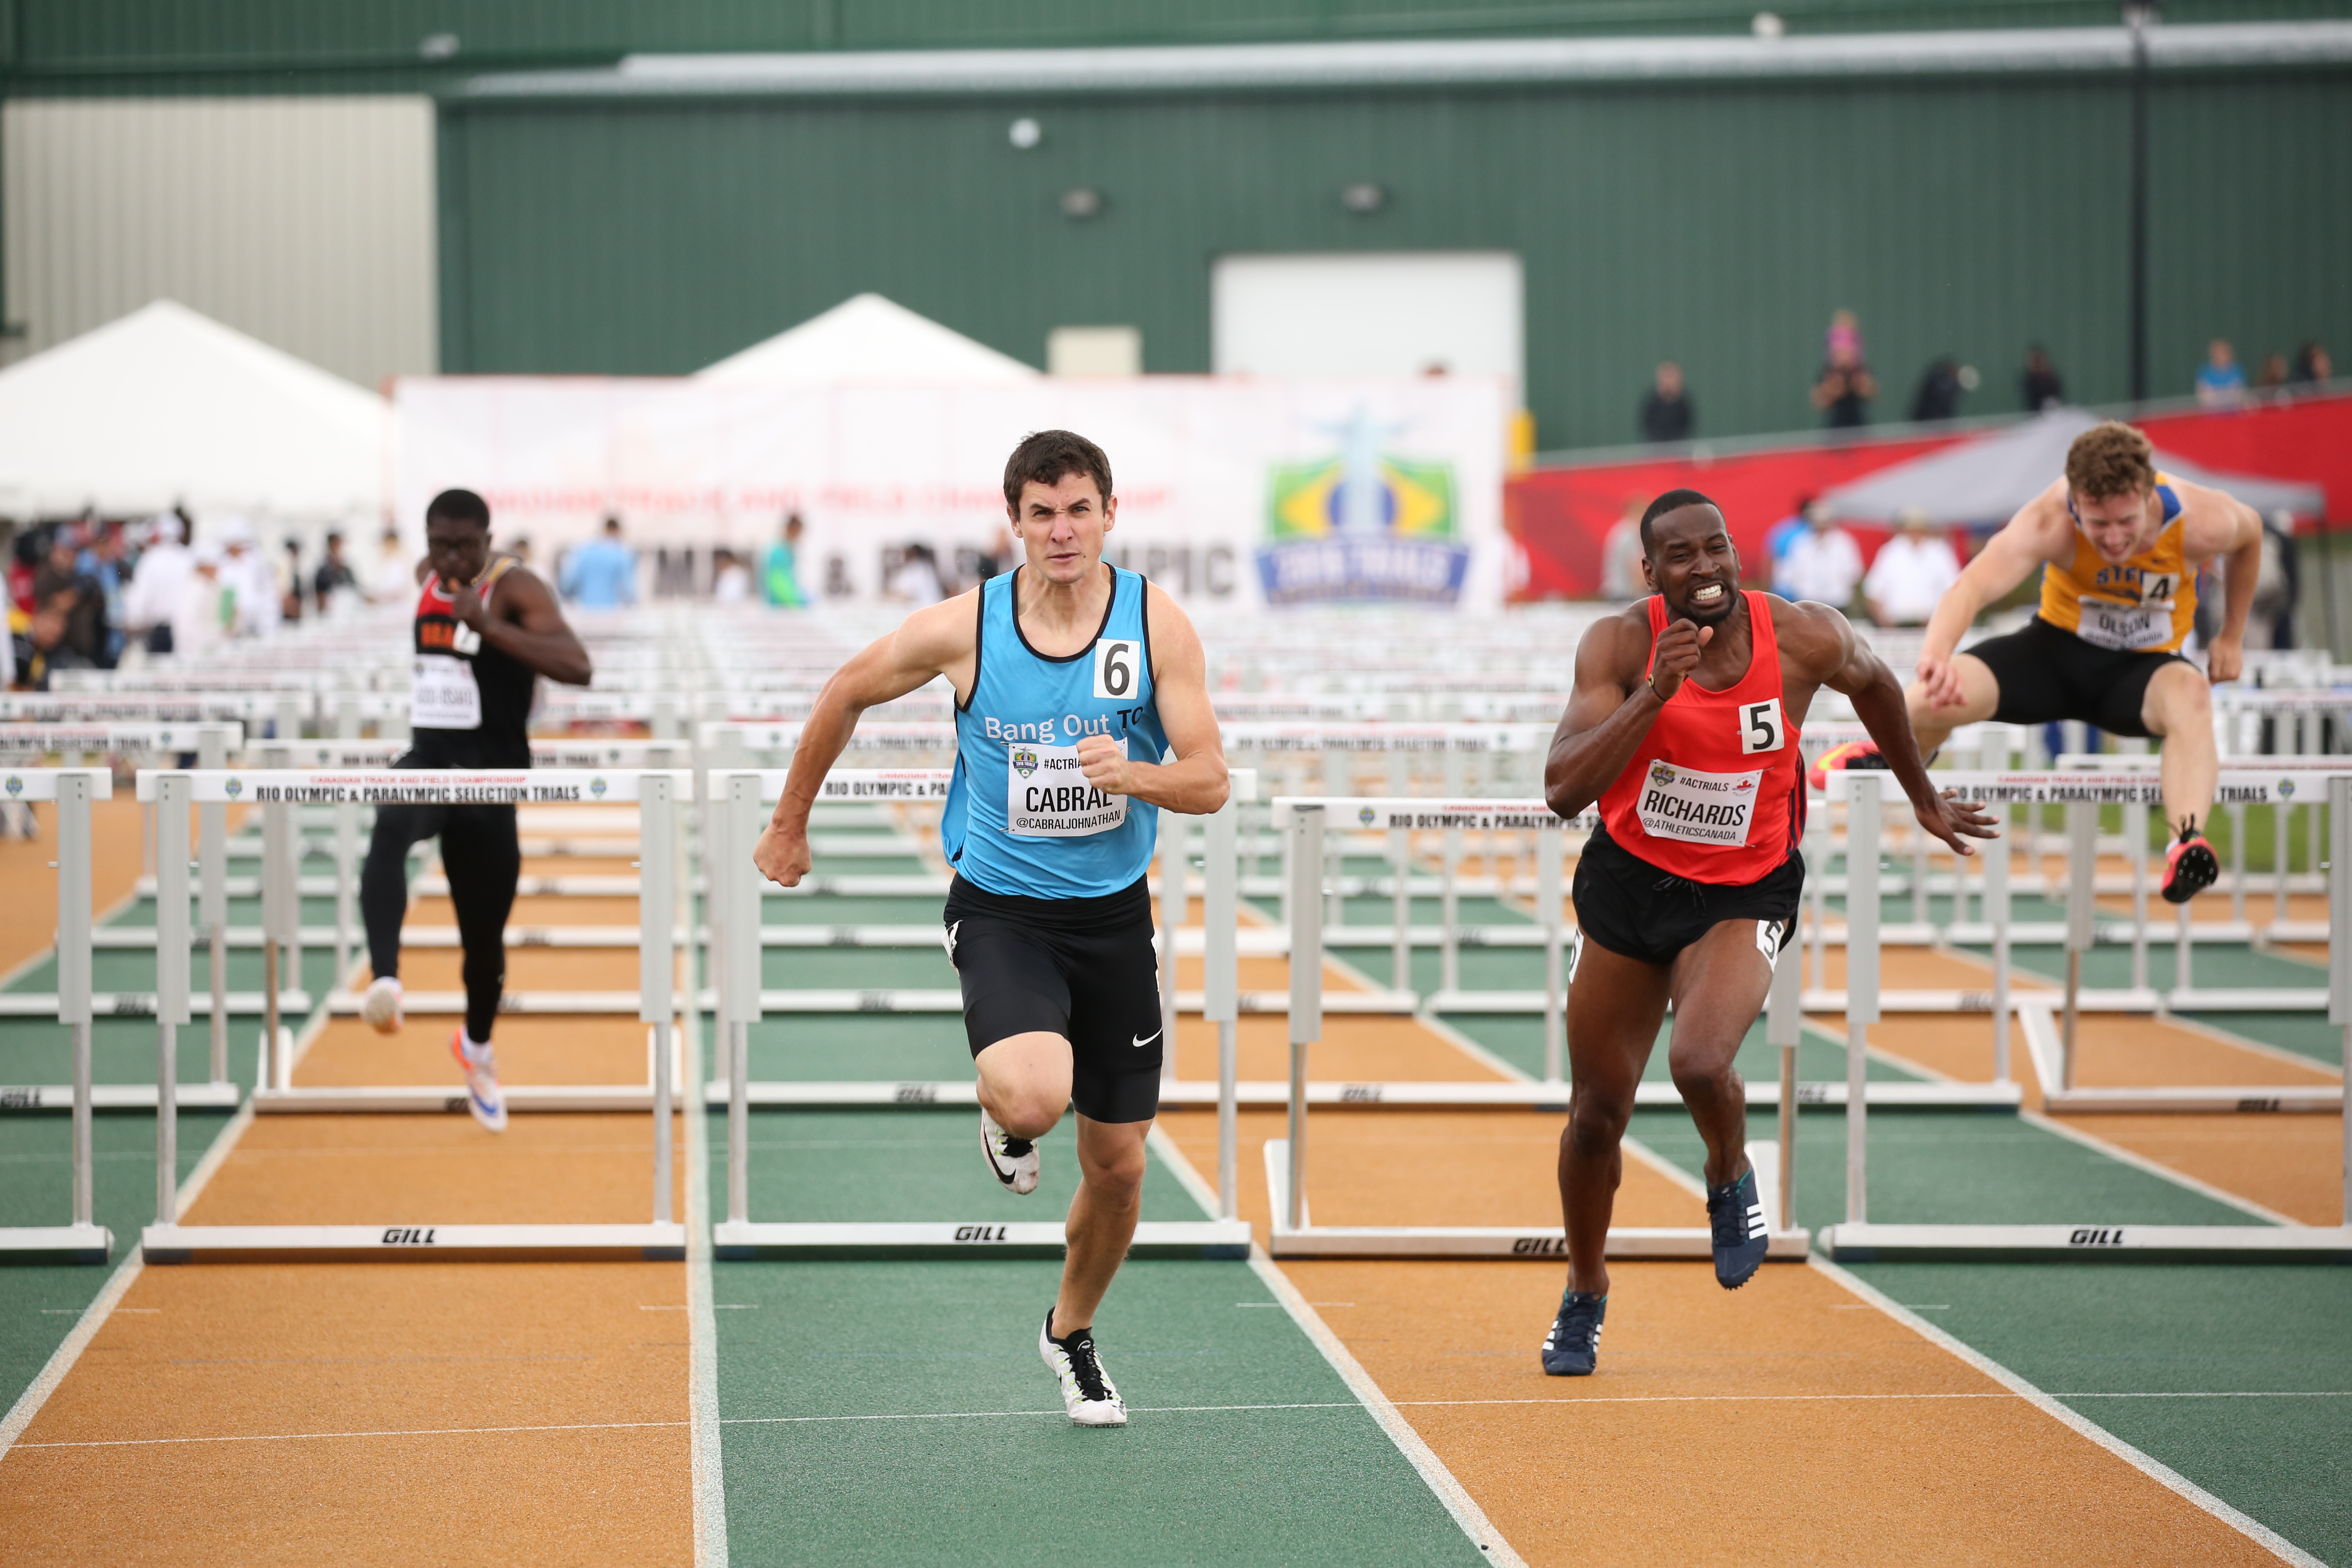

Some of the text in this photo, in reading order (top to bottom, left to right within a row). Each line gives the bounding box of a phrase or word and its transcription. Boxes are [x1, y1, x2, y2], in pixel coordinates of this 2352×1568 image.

[2149, 576, 2169, 599] 4
[2099, 612, 2150, 637] OLSON
[1104, 643, 1130, 696] 6
[984, 717, 1056, 744] Bang
[1063, 714, 1111, 737] Out
[1116, 706, 1143, 730] TC
[1750, 704, 1775, 750] 5
[825, 783, 848, 795] RIO
[853, 783, 912, 795] OLYMPIC
[918, 785, 925, 795] &
[1679, 776, 1729, 792] #ACTRIALS
[256, 787, 580, 800] RIO OLYMPIC & PARALYMPIC SELECTION TRIALS
[1025, 786, 1113, 813] CABRAL
[1973, 787, 2032, 800] OLYMPIC
[2051, 787, 2136, 801] PARALYMPIC
[2221, 787, 2267, 800] TRIALS
[1644, 790, 1746, 826] RICHARDS
[1016, 810, 1120, 829] @CABRALJOHNATHAN
[1390, 815, 1412, 828] RIO
[1417, 815, 1476, 828] OLYMPIC
[1482, 817, 1490, 828] &
[1495, 815, 1581, 828] PARALYMPIC
[1643, 817, 1736, 840] @ATHLETICSCANADA
[382, 1229, 434, 1243] GILL
[955, 1227, 1005, 1240] GILL
[2070, 1230, 2122, 1243] GILL
[1513, 1238, 1564, 1252] GILL
